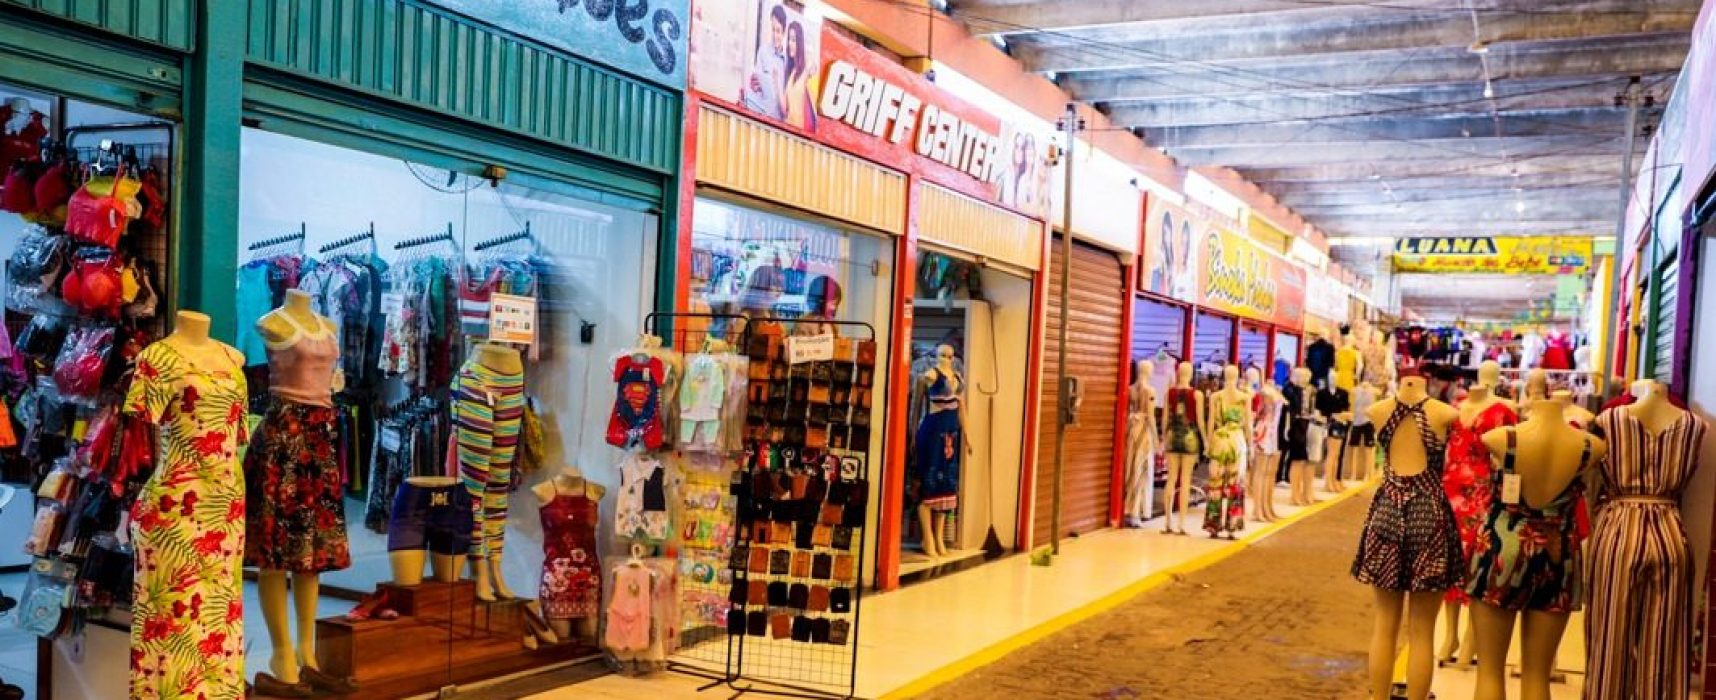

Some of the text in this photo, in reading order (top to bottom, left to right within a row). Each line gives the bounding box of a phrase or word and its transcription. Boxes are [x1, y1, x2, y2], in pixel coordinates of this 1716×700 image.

[819, 59, 1000, 183] GRIFF CENTER
[1399, 238, 1490, 253] LUANA
